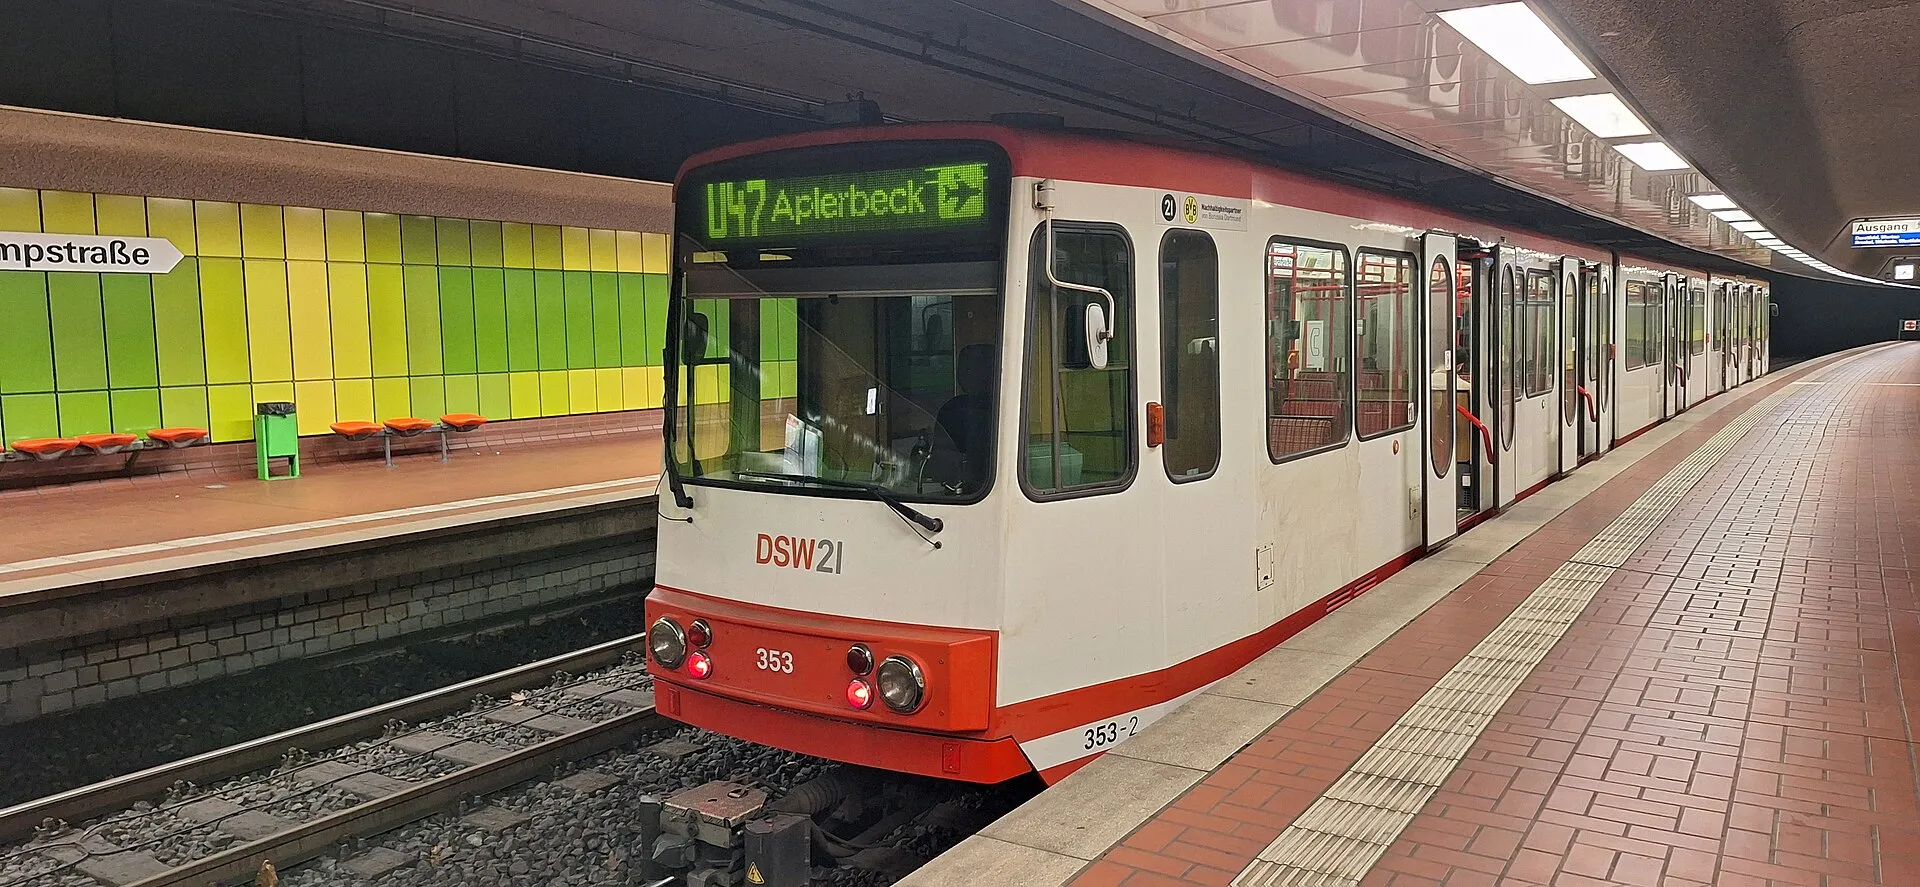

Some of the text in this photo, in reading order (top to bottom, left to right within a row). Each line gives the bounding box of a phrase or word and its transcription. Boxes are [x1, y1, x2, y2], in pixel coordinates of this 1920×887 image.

[707, 179, 926, 239] U47 Aplerbeck
[1164, 199, 1174, 216] 21
[1186, 199, 1196, 215] BVB
[1856, 224, 1908, 232] Ausgang
[0, 239, 150, 268] mpstraße
[756, 533, 843, 575] DSW21
[756, 647, 794, 674] 353
[1084, 716, 1139, 750] 353-2
